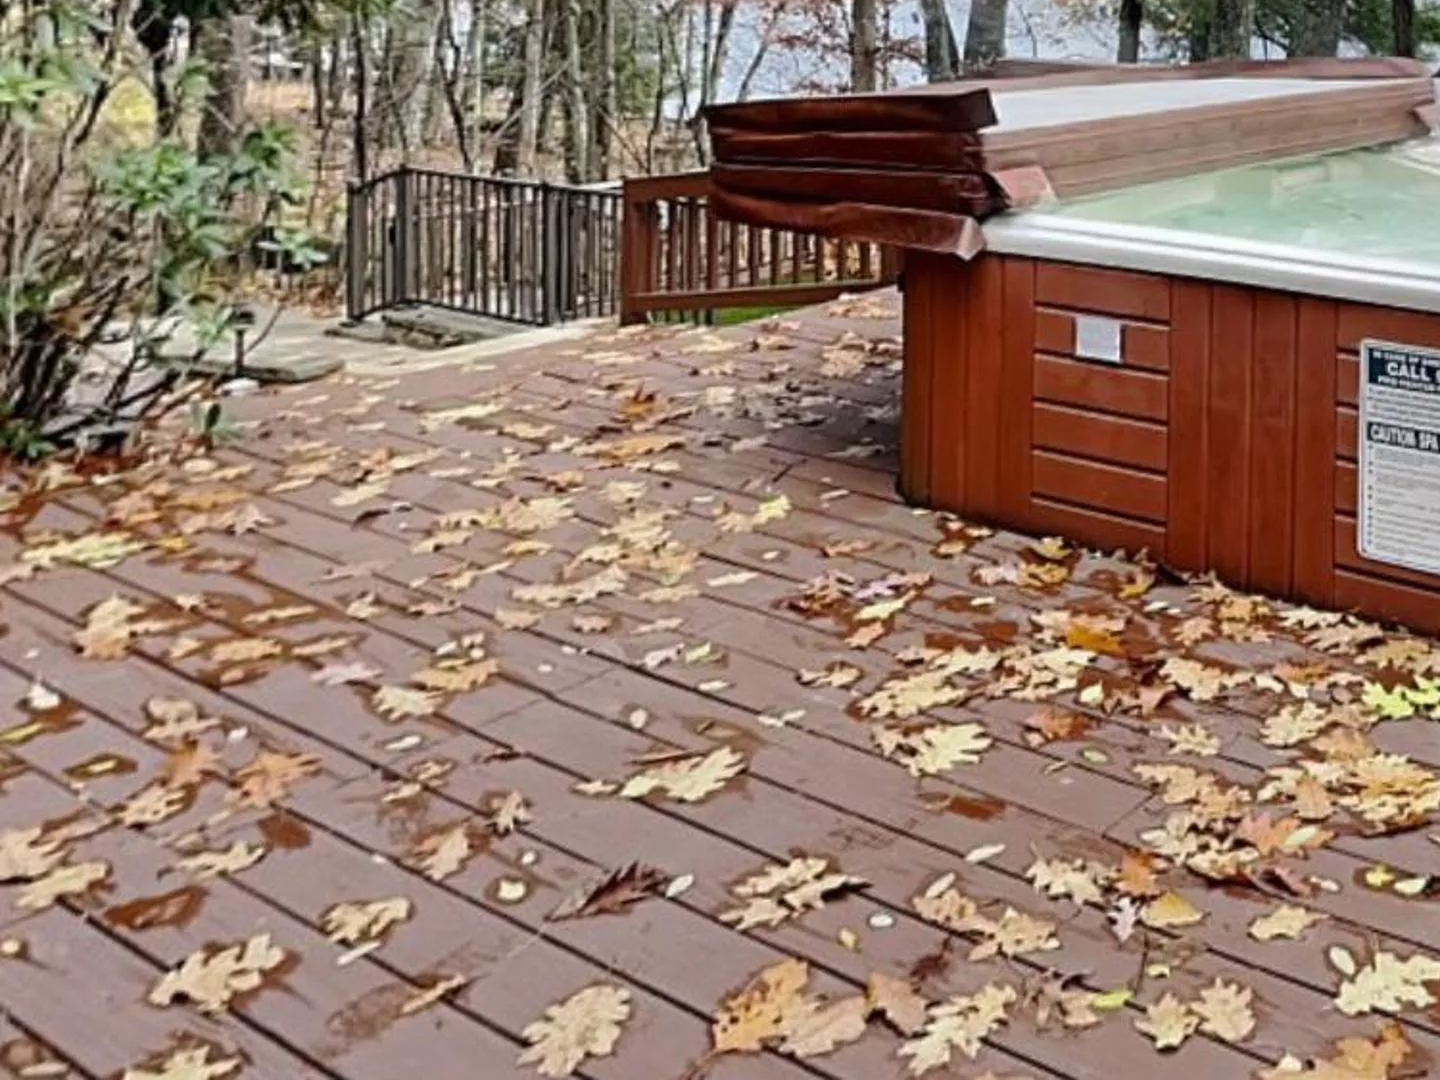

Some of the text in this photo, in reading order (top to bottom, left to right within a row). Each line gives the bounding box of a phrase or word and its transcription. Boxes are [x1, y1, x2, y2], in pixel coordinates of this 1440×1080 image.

[1387, 362, 1431, 382] CALL
[1370, 424, 1416, 448] CAUTION
[1419, 431, 1439, 451] SPA
